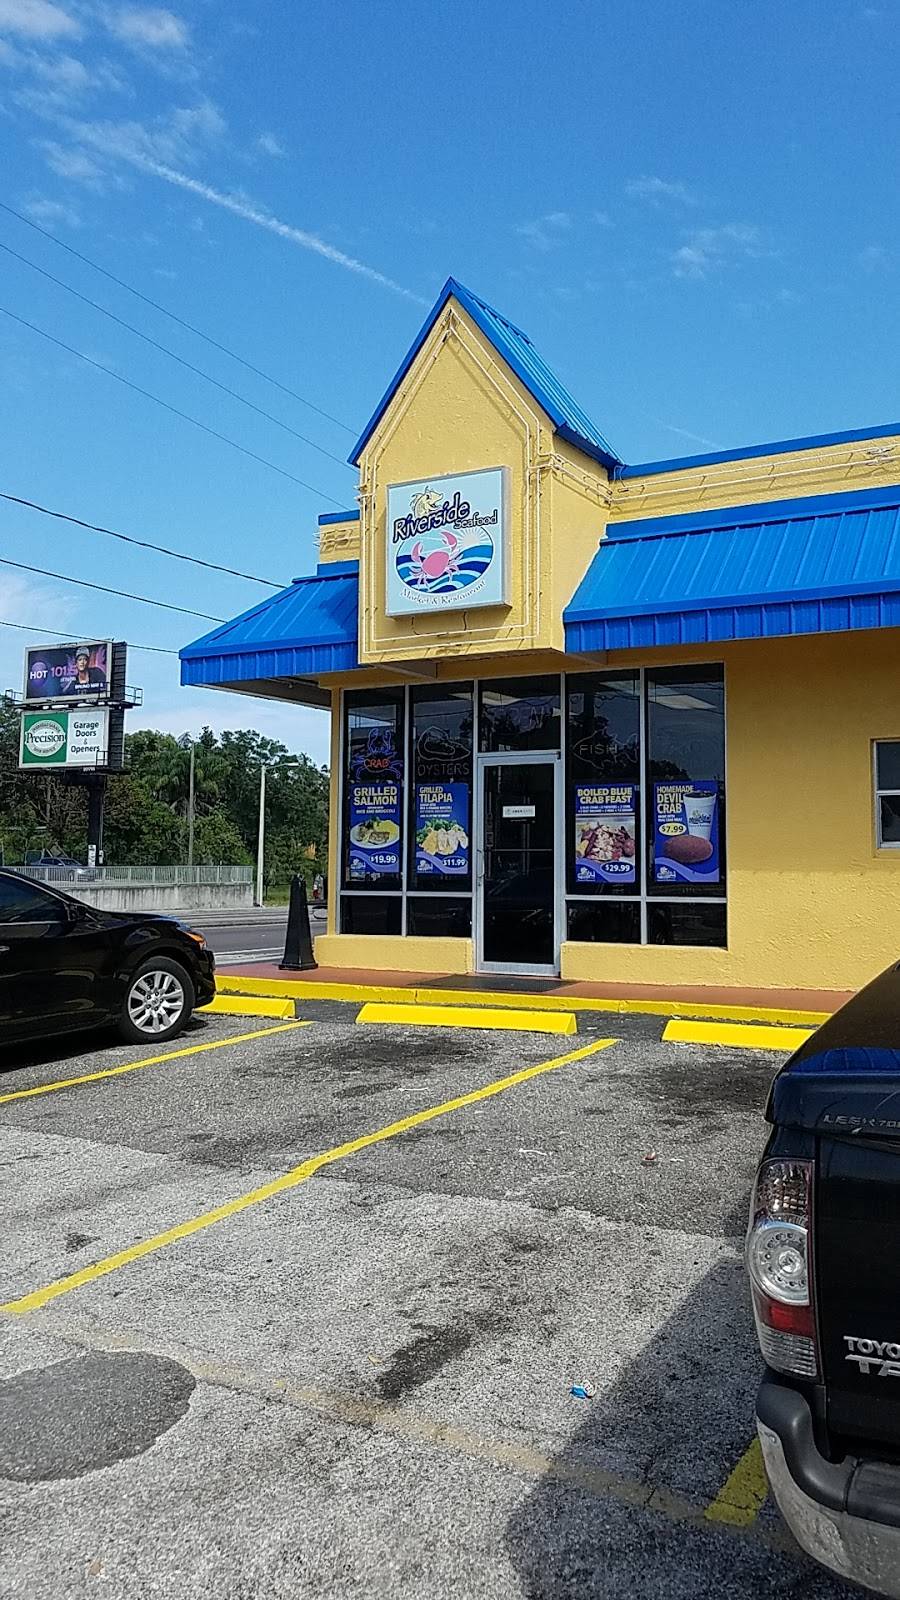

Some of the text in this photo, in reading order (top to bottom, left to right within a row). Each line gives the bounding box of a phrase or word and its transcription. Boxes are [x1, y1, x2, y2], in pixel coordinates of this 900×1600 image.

[393, 491, 470, 543] Riverside
[29, 670, 48, 680] HOT
[50, 665, 78, 678] 101.5
[73, 721, 100, 730] Garage
[26, 731, 65, 744] Precision
[75, 729, 97, 737] Doors
[71, 745, 100, 754] Openers
[579, 743, 618, 755] FISH
[366, 758, 390, 769] CRAB
[418, 762, 470, 777] OYSTERS
[353, 786, 398, 797] GRILLED
[419, 786, 444, 794] GRILLED
[577, 787, 633, 797] BOILED BLUE
[656, 785, 694, 793] HOMEMADE
[353, 795, 398, 806] SALMON
[419, 793, 453, 803] TILAPIA
[580, 795, 632, 804] CRAB FEAST
[657, 793, 684, 804] DEVIL
[656, 803, 682, 814] CRAB
[661, 825, 684, 833] $7.99
[370, 855, 397, 864] $19.99
[443, 857, 466, 866] $11.99
[605, 864, 630, 872] $29.99
